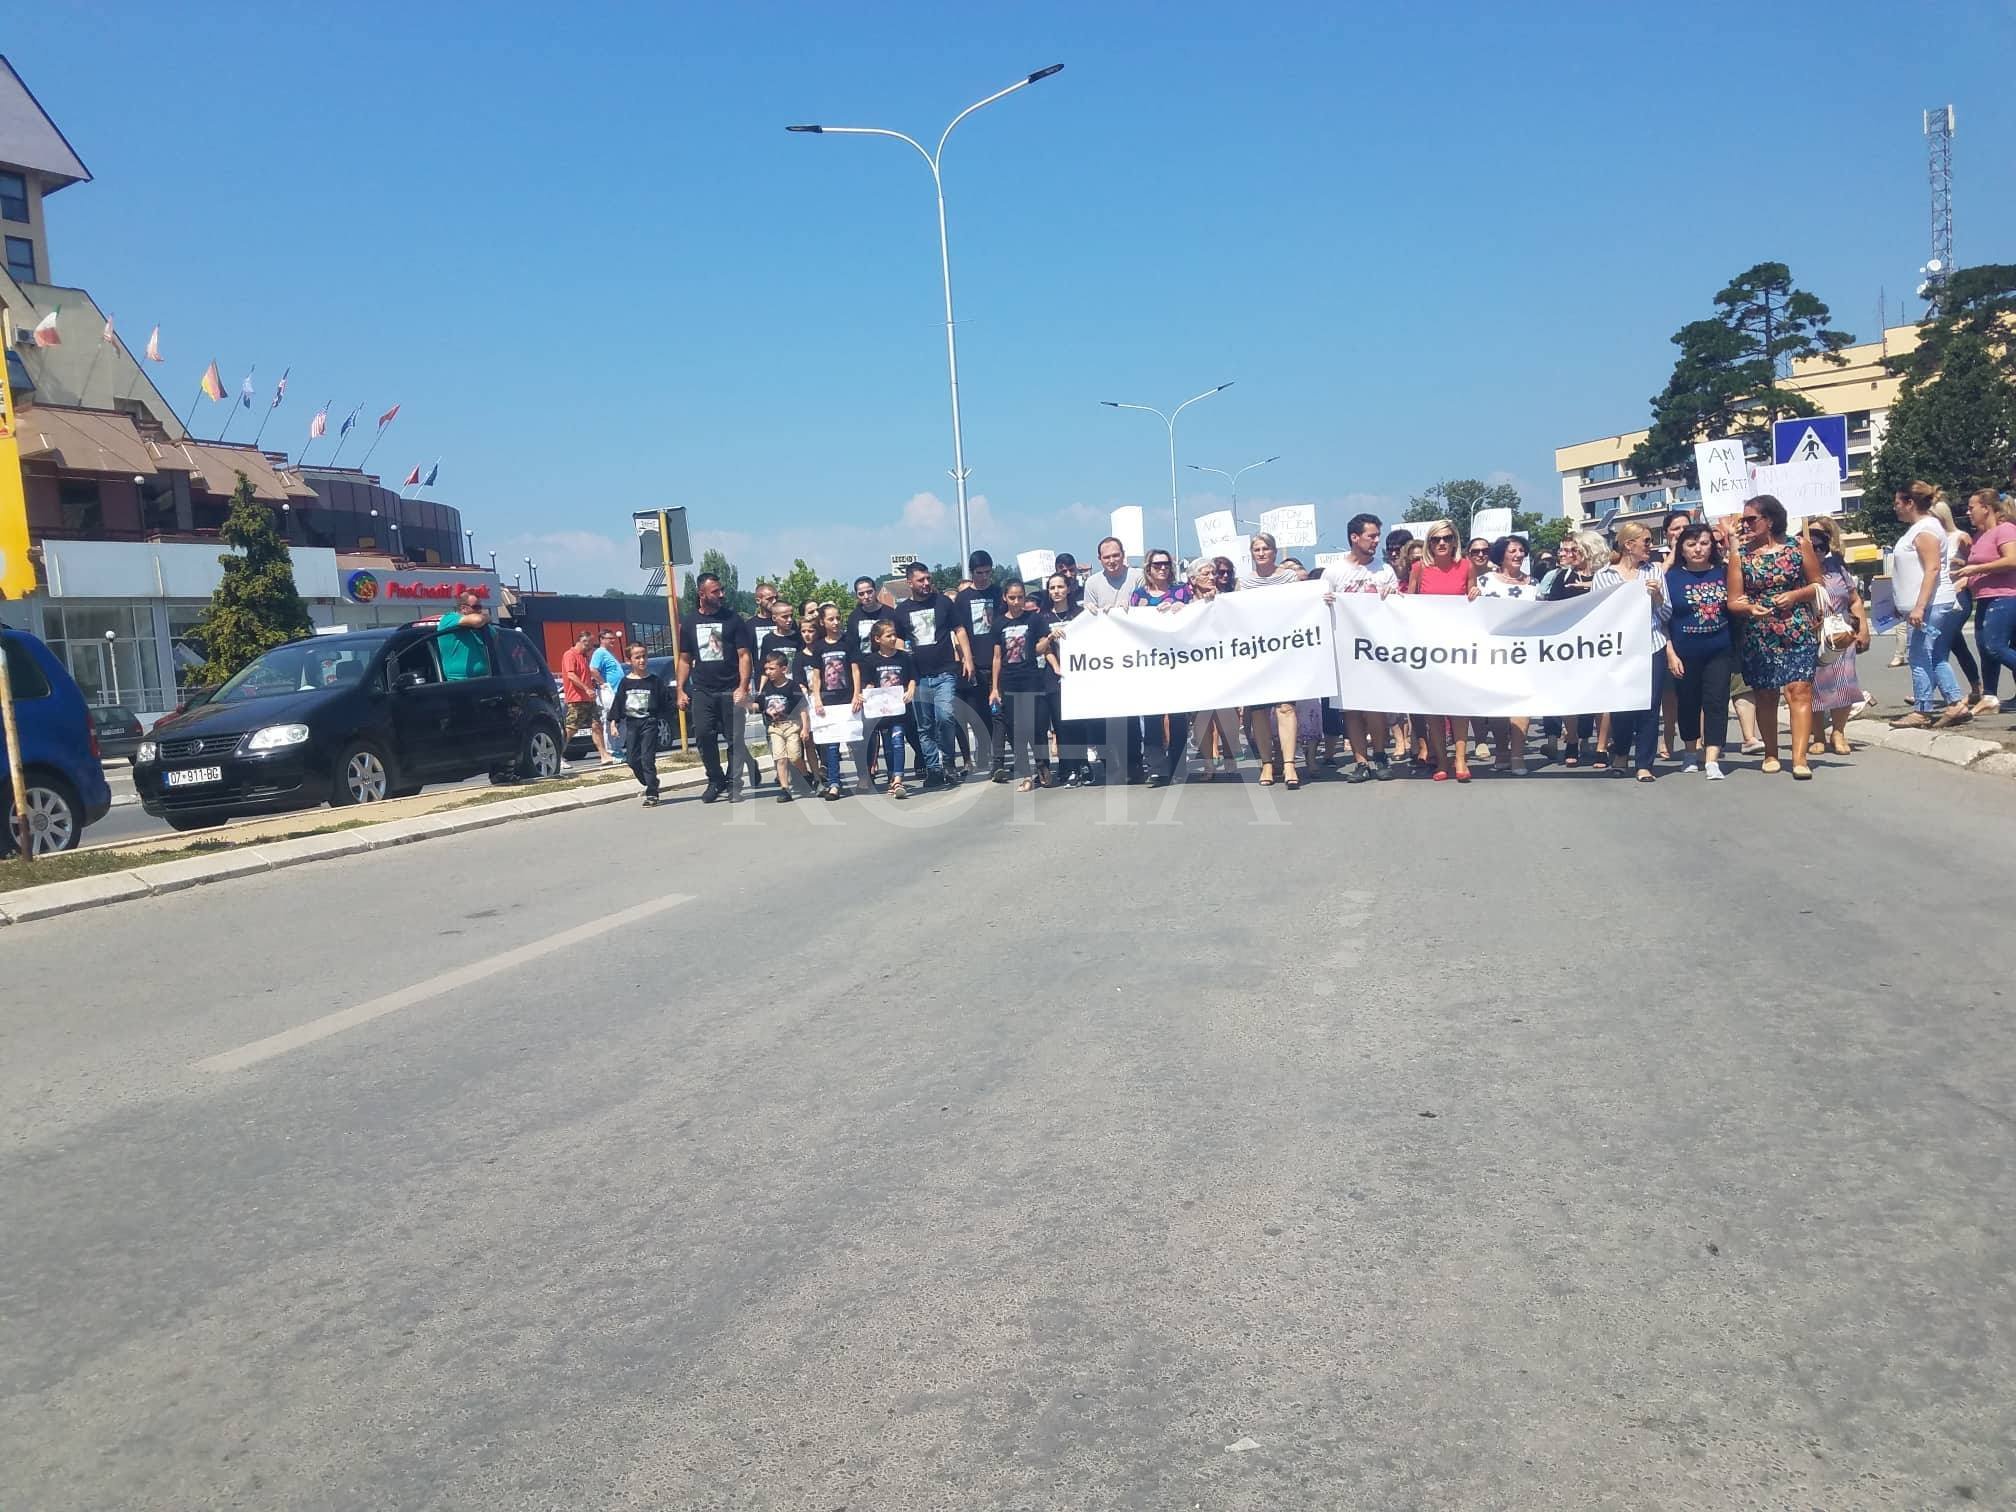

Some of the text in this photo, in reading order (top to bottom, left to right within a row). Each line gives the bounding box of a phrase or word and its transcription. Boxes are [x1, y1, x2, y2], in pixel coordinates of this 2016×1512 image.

[1708, 447, 1735, 463] AM
[1724, 462, 1731, 474] I
[1069, 626, 1322, 672] Mos shfajsoni fajtorët!
[1354, 632, 1623, 669] Reagoni në kohë!
